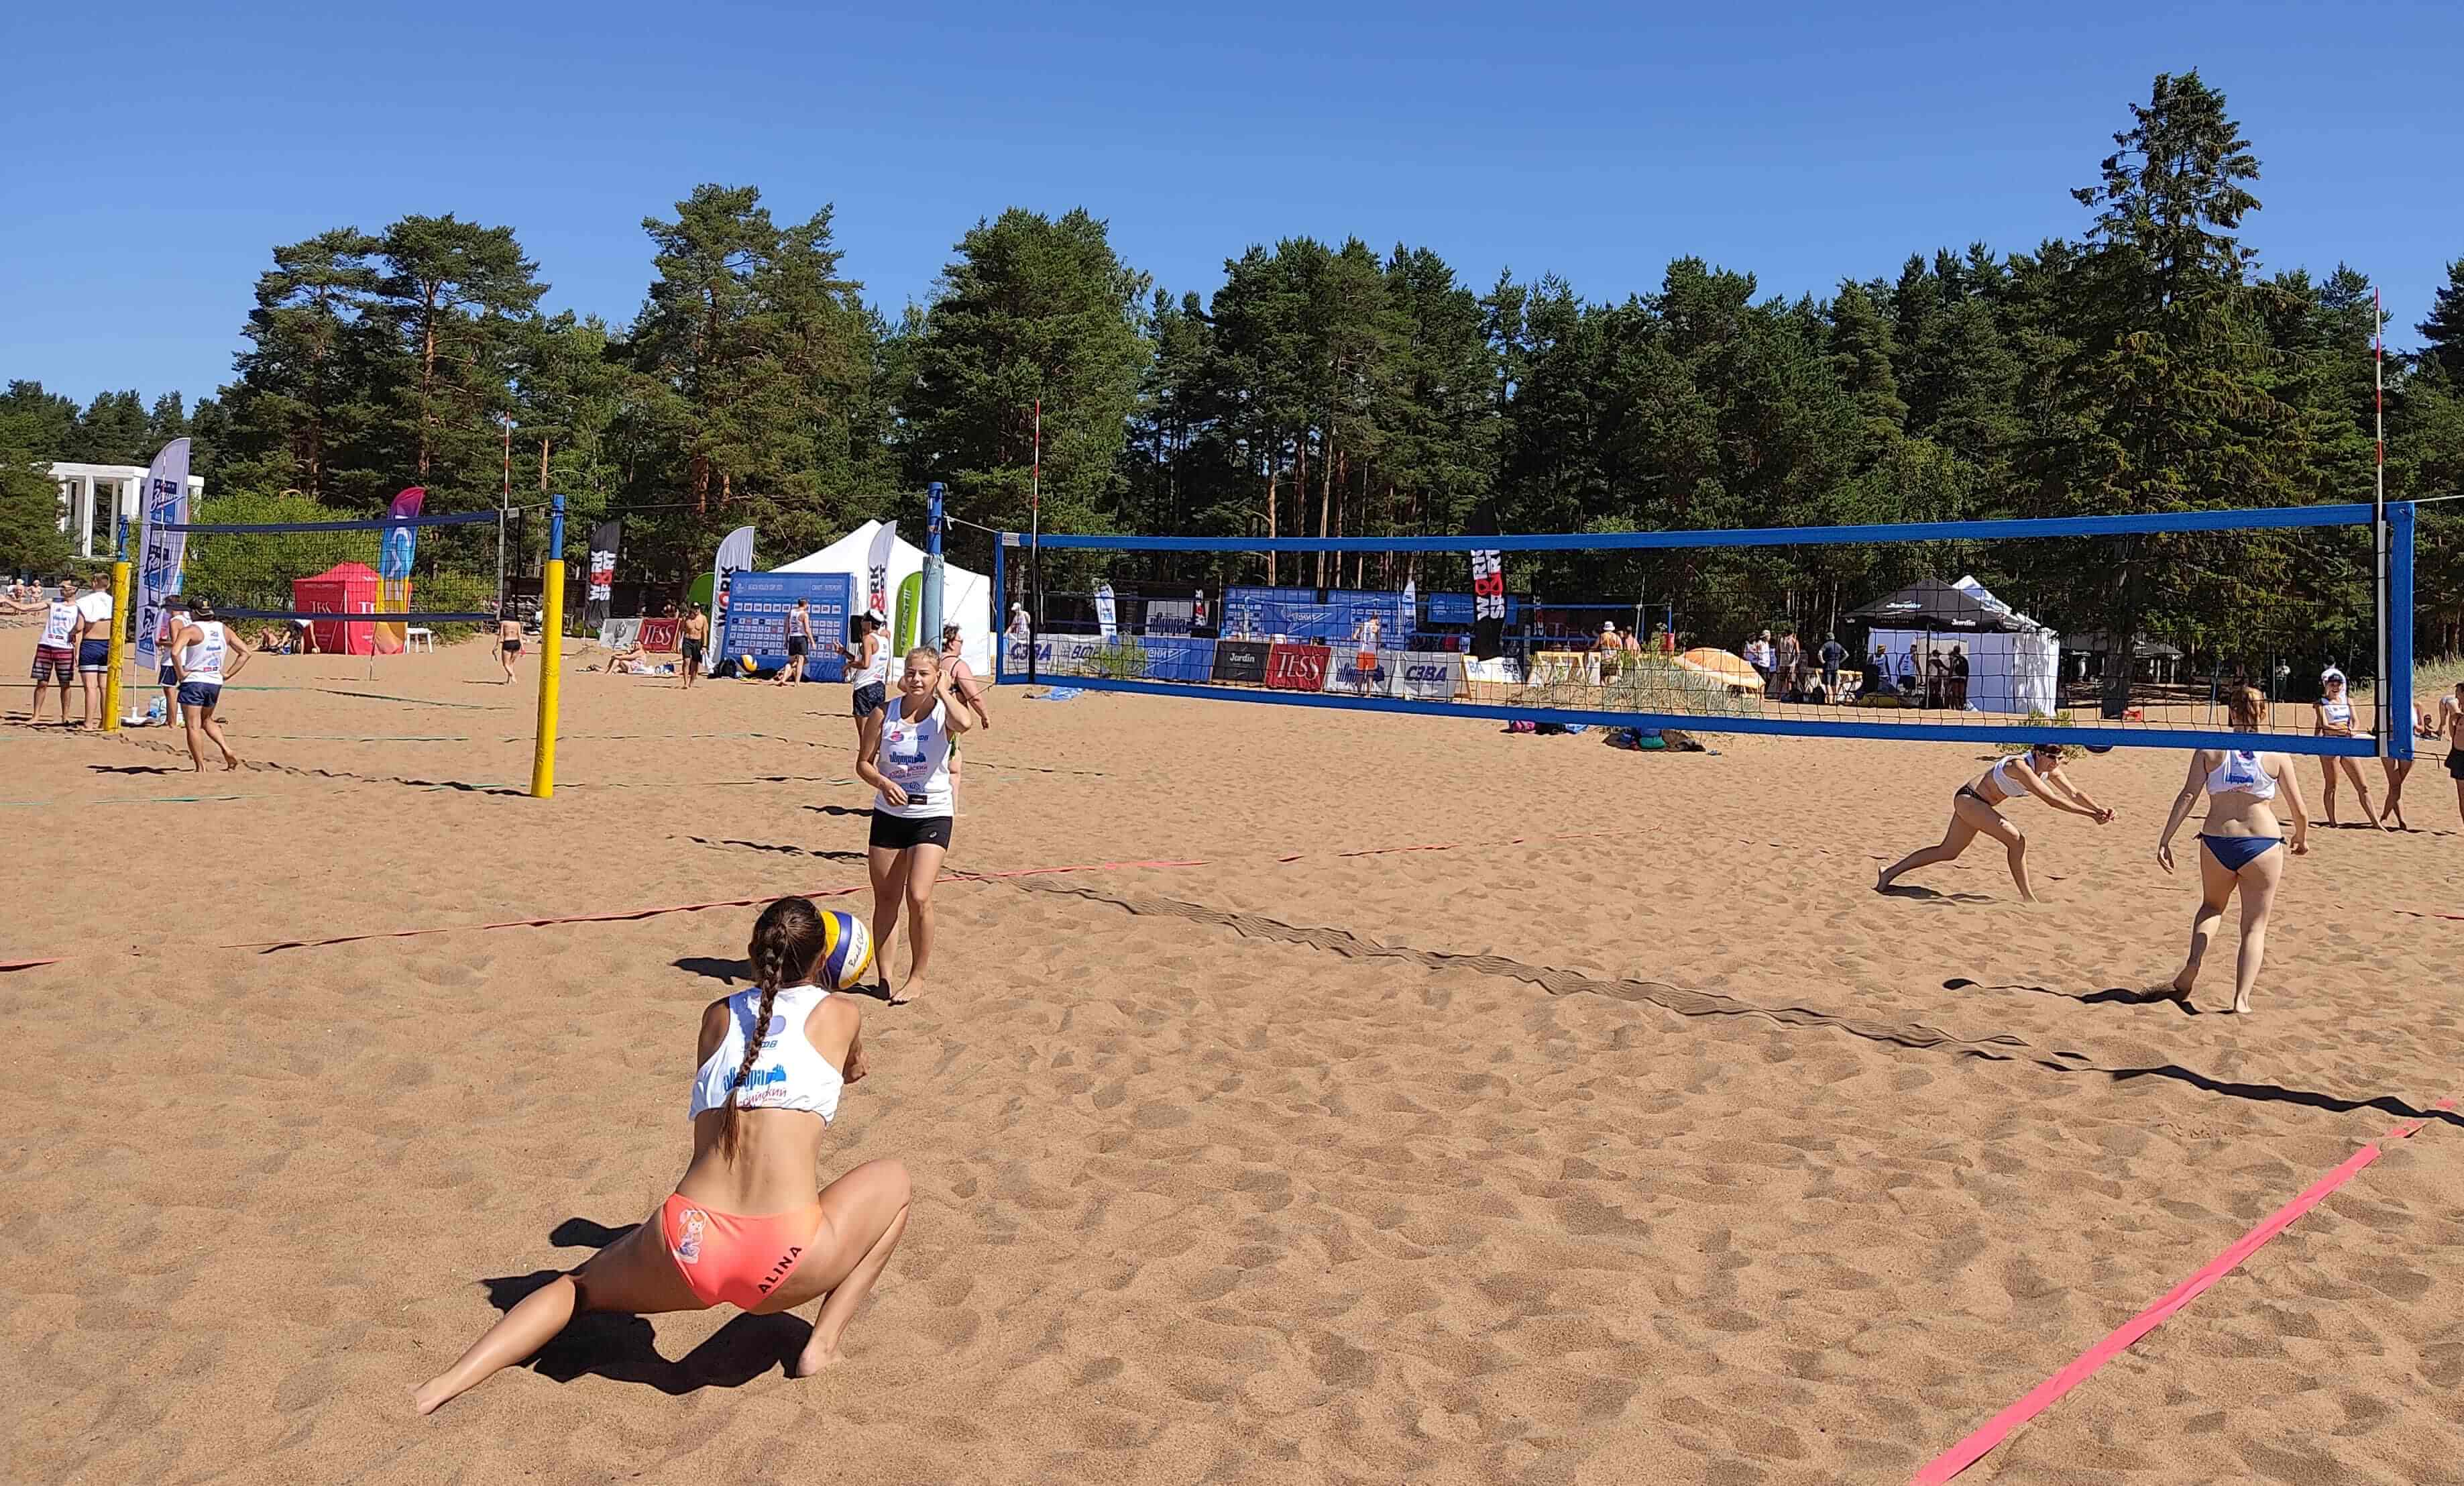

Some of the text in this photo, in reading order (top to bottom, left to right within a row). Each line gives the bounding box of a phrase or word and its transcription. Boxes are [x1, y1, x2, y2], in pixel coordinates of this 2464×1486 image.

[644, 624, 676, 645] TESS
[1229, 652, 1255, 663] Jardin
[1277, 651, 1319, 681] TESS
[758, 1245, 803, 1295] ALINA
